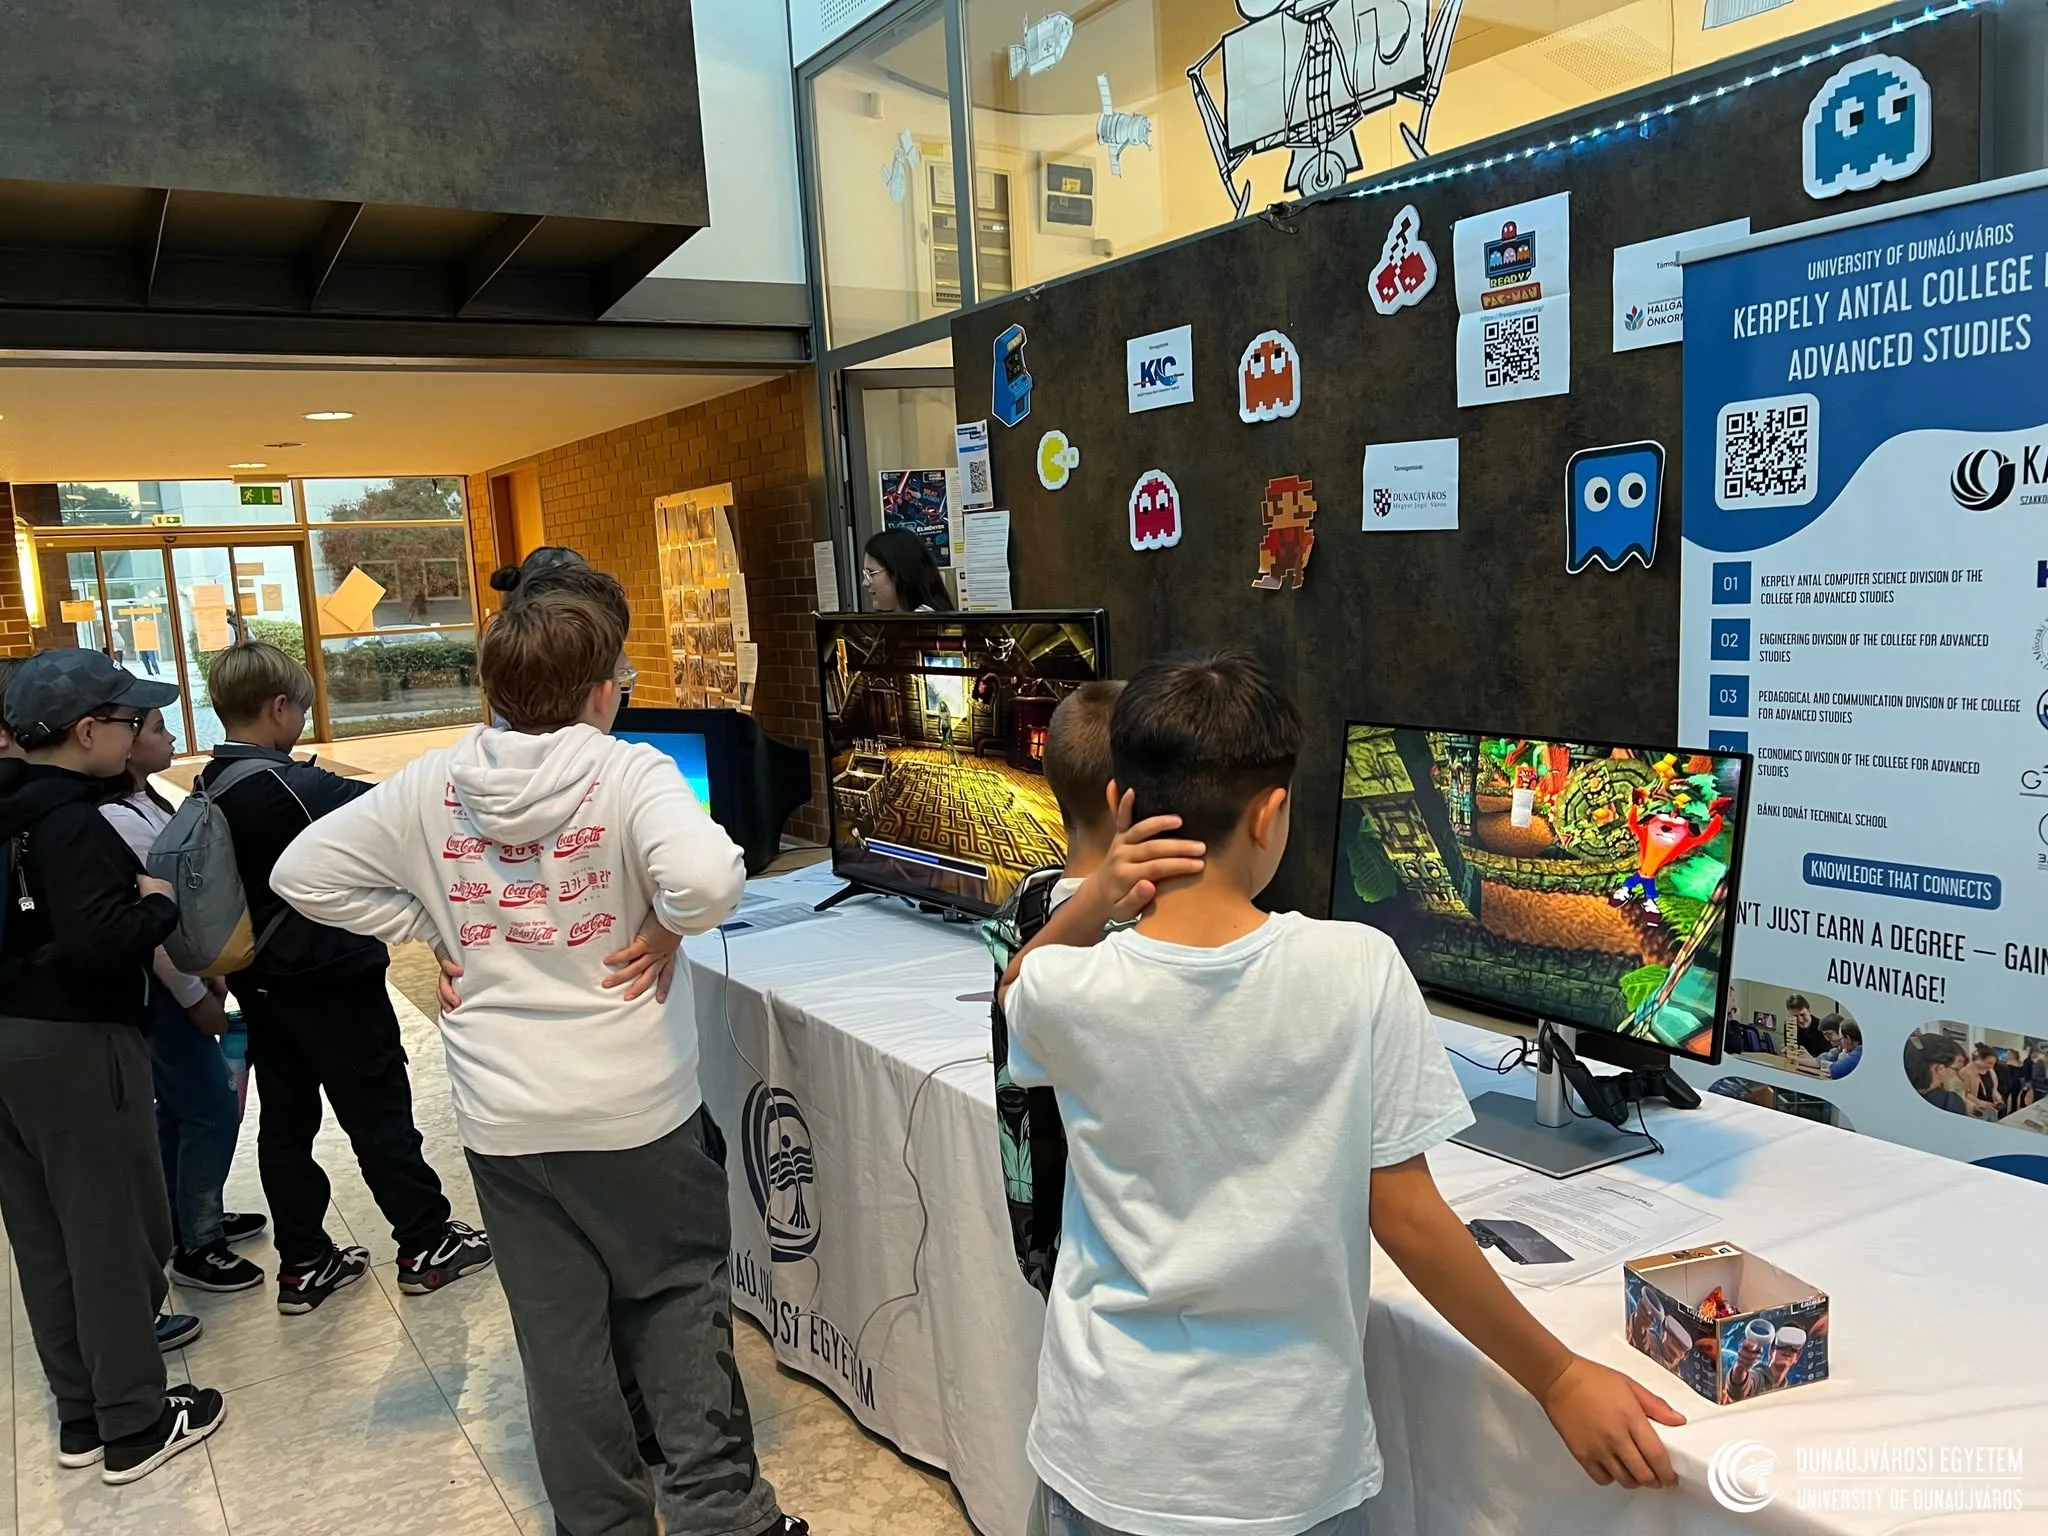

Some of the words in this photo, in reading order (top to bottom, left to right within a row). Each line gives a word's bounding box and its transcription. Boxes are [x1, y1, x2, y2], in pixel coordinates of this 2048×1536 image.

[1808, 249, 1882, 280] UNIVERSITY
[1886, 244, 1904, 266] OF
[1908, 223, 2014, 262] DUNAÚJVÁROS
[1490, 271, 1531, 288] READY!
[1733, 291, 1830, 340] KERPELY
[1838, 277, 1912, 322] ANTAL
[1922, 254, 2034, 308] COLLEGE
[1788, 331, 1913, 382] ADVANCED
[1923, 313, 2032, 364] STUDIES
[1393, 489, 1447, 502] DUNAÚJVÁROS
[1723, 576, 1738, 591] 01
[1760, 575, 1795, 587] KERPELY
[1797, 574, 1822, 586] ANTAL
[1824, 572, 1870, 586] COMPUTER
[1872, 571, 1908, 585] SCIENCE
[1910, 570, 1949, 584] DIVISION
[1951, 569, 1964, 583] OF
[1966, 569, 1984, 582] THE
[1760, 593, 1793, 605] COLLEGE
[1795, 592, 1811, 605] FOR
[1813, 591, 1857, 604] ADVANCED
[1859, 590, 1895, 603] STUDIES
[1720, 633, 1739, 648] 02
[1759, 633, 1810, 645] ENGINEERING
[1812, 634, 1847, 646] DIVISION
[1849, 634, 1861, 646] OF
[1863, 634, 1878, 646] THE
[1880, 633, 1917, 646] COLLEGE
[1919, 633, 1937, 646] FOR
[1940, 634, 1989, 647] ADVANCED
[1759, 650, 1791, 663] STUDIES
[1719, 689, 1737, 704] 03
[1758, 690, 1811, 704] PEDAGOGICAL
[1813, 692, 1830, 705] AND
[1832, 693, 1903, 707] COMMUNICATION
[1905, 695, 1944, 709] DIVISION
[1947, 697, 1959, 710] OF
[1962, 697, 1978, 711] THE
[1981, 698, 2021, 712] COLLEGE
[1758, 707, 1774, 720] FOR
[1775, 709, 1817, 722] ADVANCED
[1819, 711, 1853, 724] STUDIES
[1758, 747, 1802, 762] ECONOMICS
[1804, 751, 1840, 765] DIVISION
[1841, 753, 1852, 765] OF
[1854, 754, 1870, 767] THE
[1872, 755, 1909, 769] COLLEGE
[1911, 757, 1929, 771] FOR
[1931, 759, 1980, 775] ADVANCED
[1757, 764, 1789, 778] STUDIES
[1757, 802, 1781, 817] BÁNKI
[1782, 805, 1808, 820] DONÁT
[1810, 808, 1853, 825] TECHNICAL
[1855, 813, 1888, 829] SCHOOL
[1811, 860, 1884, 887] KNOWLEDGE
[1888, 870, 1919, 894] THAT
[1923, 874, 1992, 901] CONNECTS
[1766, 906, 1810, 936] JUST
[1816, 913, 1864, 945] EARN
[1871, 922, 1883, 949] A
[1890, 924, 1966, 962] DEGREE
[1827, 958, 1946, 1004] ADVANTAGE!
